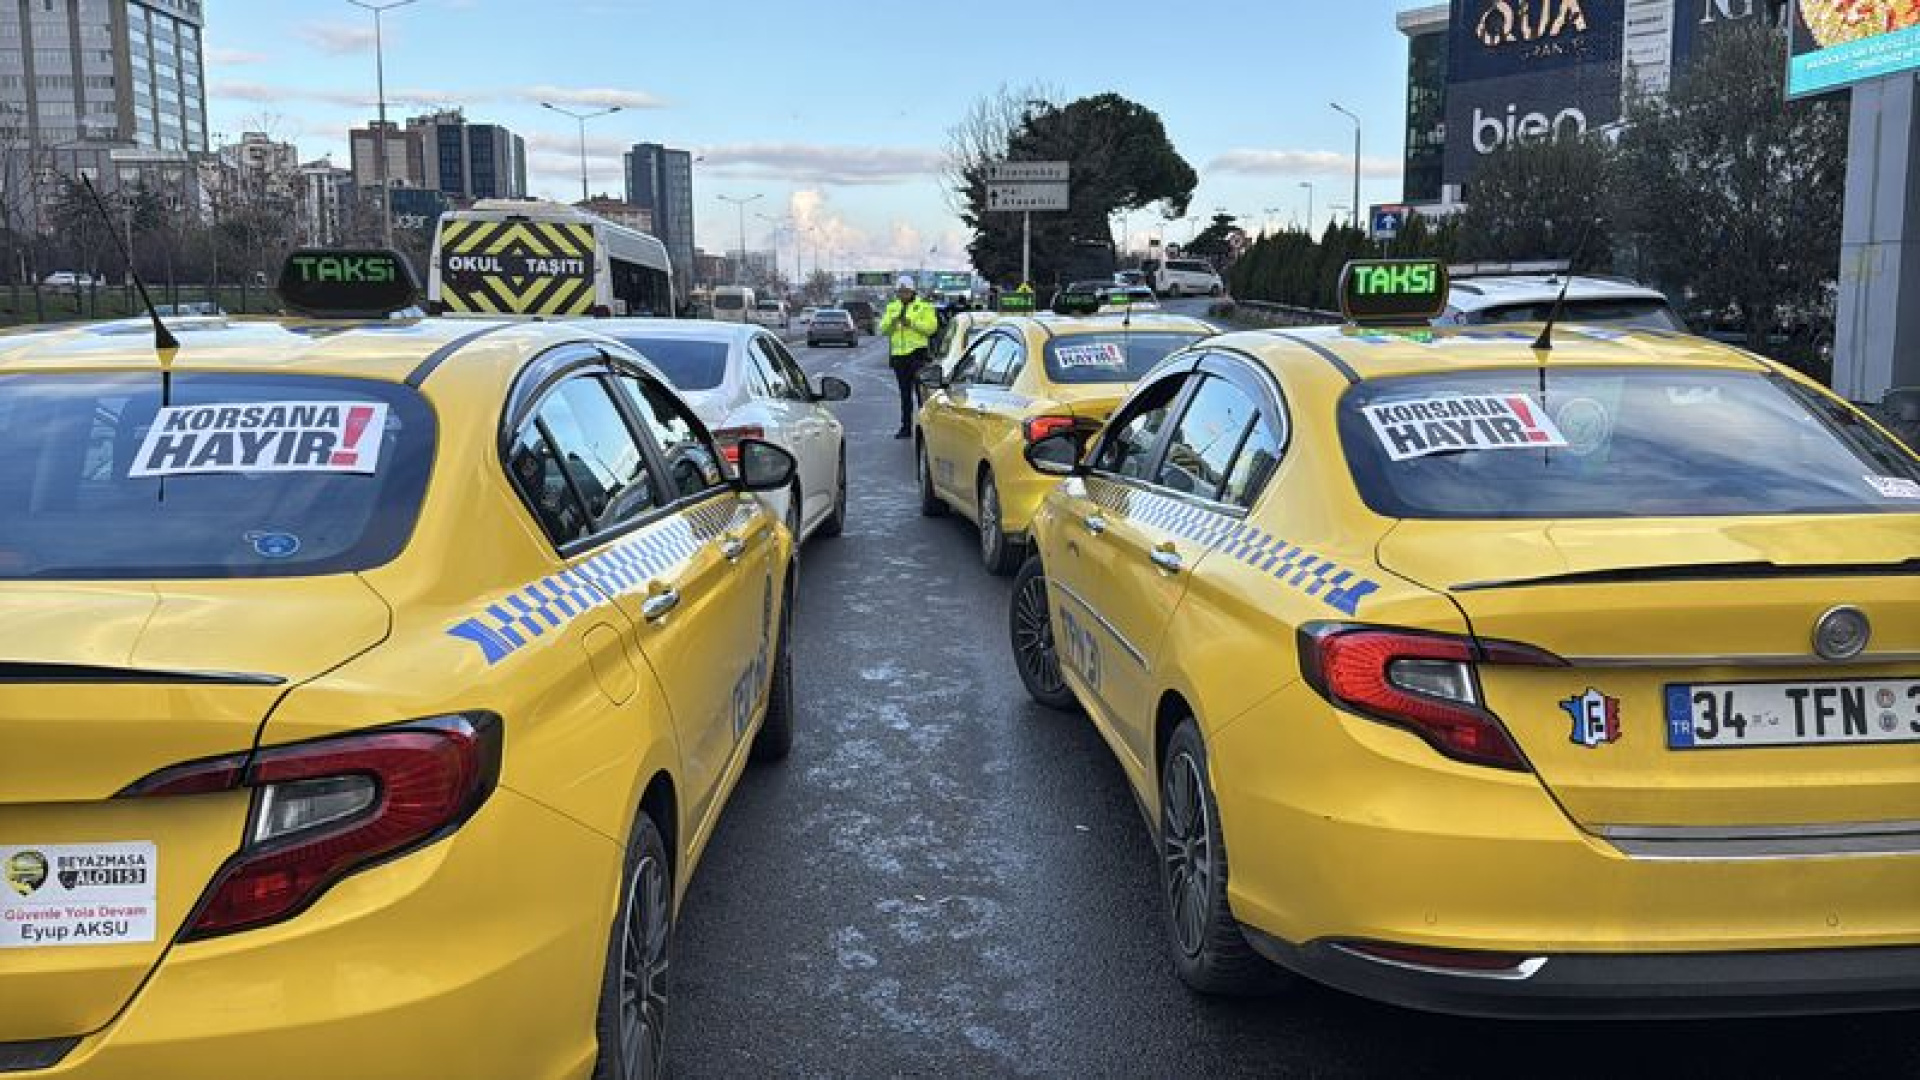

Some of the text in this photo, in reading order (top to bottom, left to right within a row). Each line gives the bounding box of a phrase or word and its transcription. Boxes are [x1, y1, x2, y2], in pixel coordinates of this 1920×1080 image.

[1472, 102, 1587, 155] bien
[448, 256, 585, 279] OKUL TAŞITI
[163, 405, 340, 430] KORSANA
[1374, 397, 1508, 426] KORSANA
[1385, 397, 1549, 455] HAYIR!
[146, 407, 374, 470] HAYIR!
[1692, 690, 1748, 740] 34
[1785, 686, 1868, 738] TFN
[1672, 721, 1692, 736] TR
[21, 921, 128, 942] Eyup AKSU
